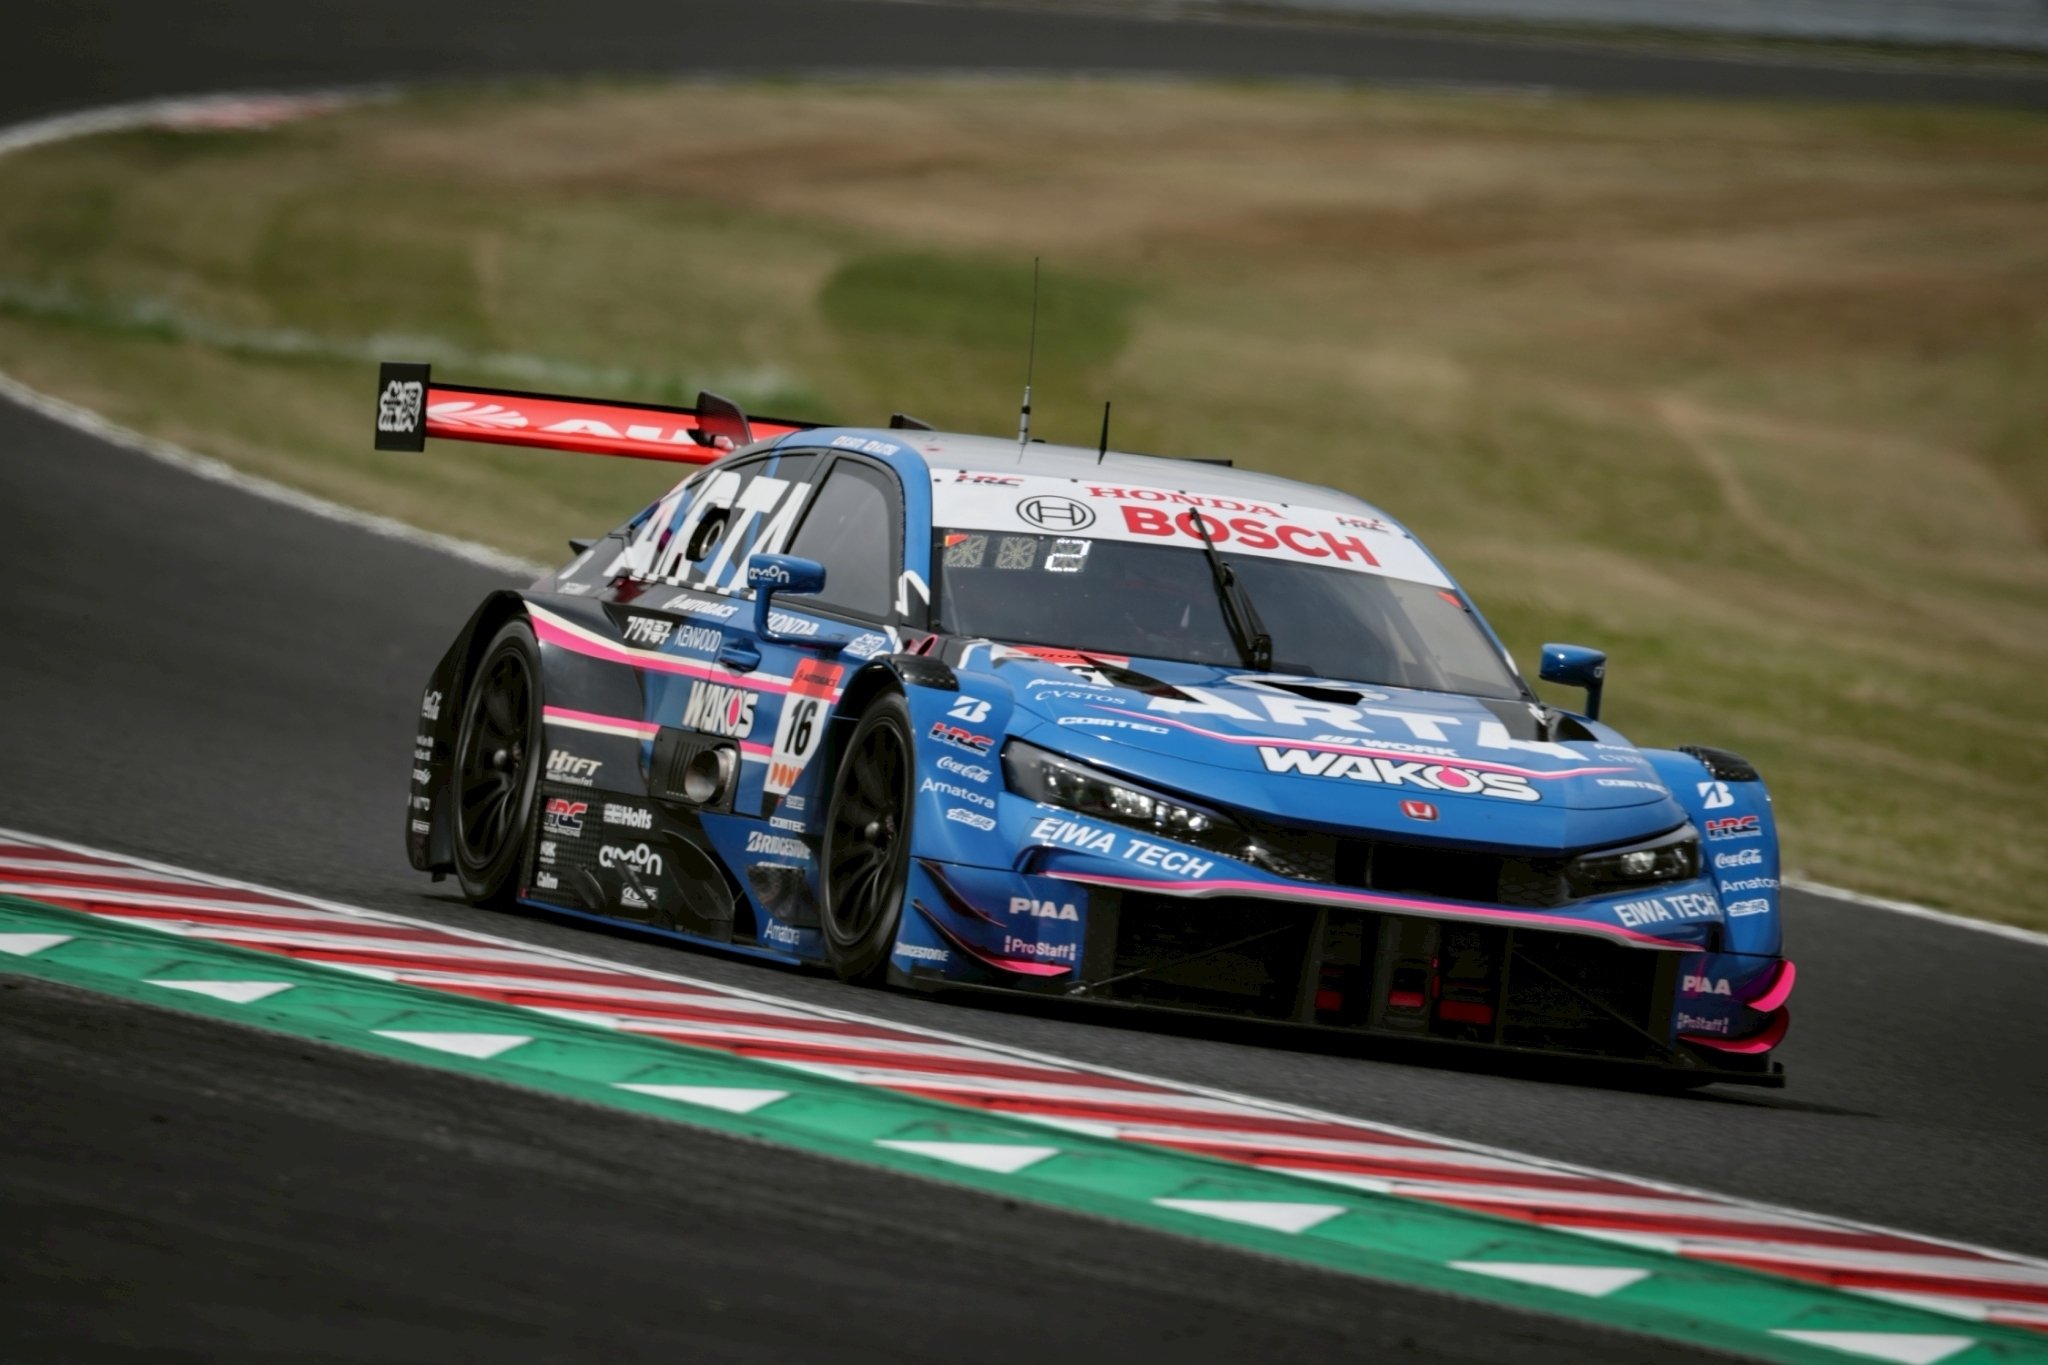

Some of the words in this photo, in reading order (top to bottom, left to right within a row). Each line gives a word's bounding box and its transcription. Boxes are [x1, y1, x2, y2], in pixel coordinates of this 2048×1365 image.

[954, 474, 1024, 487] HRC
[1085, 487, 1287, 520] HONDA
[1120, 505, 1381, 568] BOSCH
[1044, 537, 1093, 572] 2
[675, 624, 721, 653] KENWOOD
[1035, 690, 1127, 706] CVSTOS
[784, 699, 818, 757] 16
[928, 721, 995, 754] HRC
[1057, 717, 1170, 735] COMTEC
[1361, 739, 1459, 757] WORK
[920, 778, 995, 809] Amatora
[623, 806, 652, 830] Holts
[1706, 816, 1760, 837] HRC
[599, 843, 663, 876] amon
[1031, 817, 1116, 853] EIWA
[1122, 839, 1215, 878] TECH
[1009, 896, 1079, 922] PIAA
[1613, 899, 1665, 927] EIWA
[1664, 893, 1720, 920] TECH
[1682, 975, 1731, 996] PIAA
